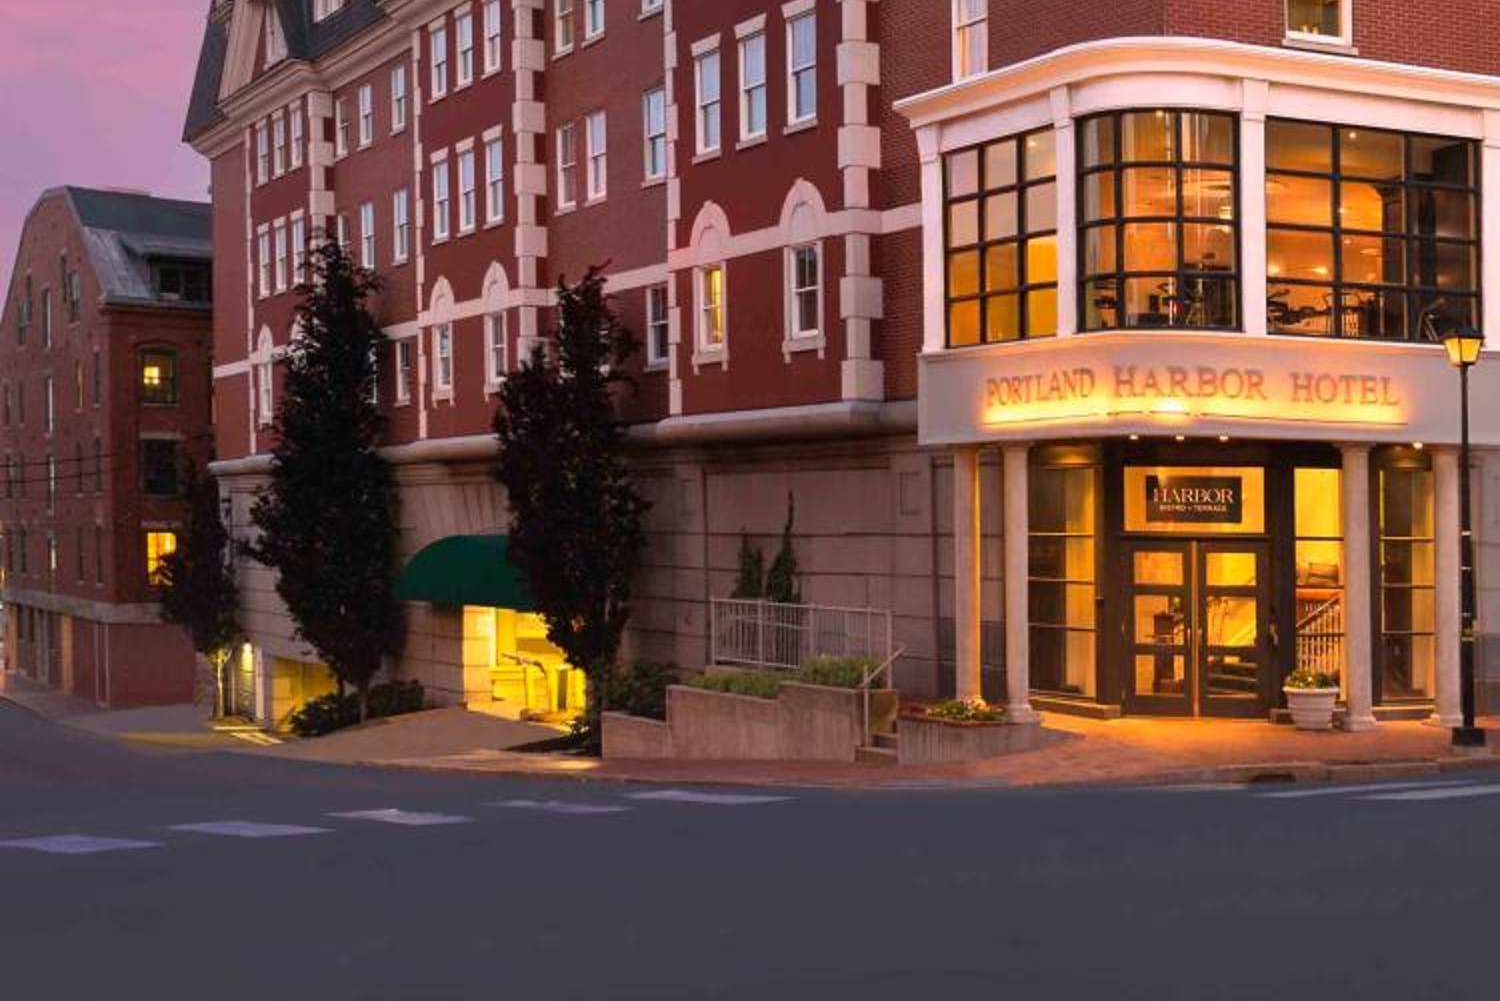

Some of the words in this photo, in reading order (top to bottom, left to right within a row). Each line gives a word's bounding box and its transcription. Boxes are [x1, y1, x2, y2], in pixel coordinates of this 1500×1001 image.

[985, 367, 1096, 408] PORTLAND
[1114, 365, 1269, 401] HARBOR
[1290, 372, 1400, 407] HOTEL
[1153, 488, 1233, 504] HARBOR
